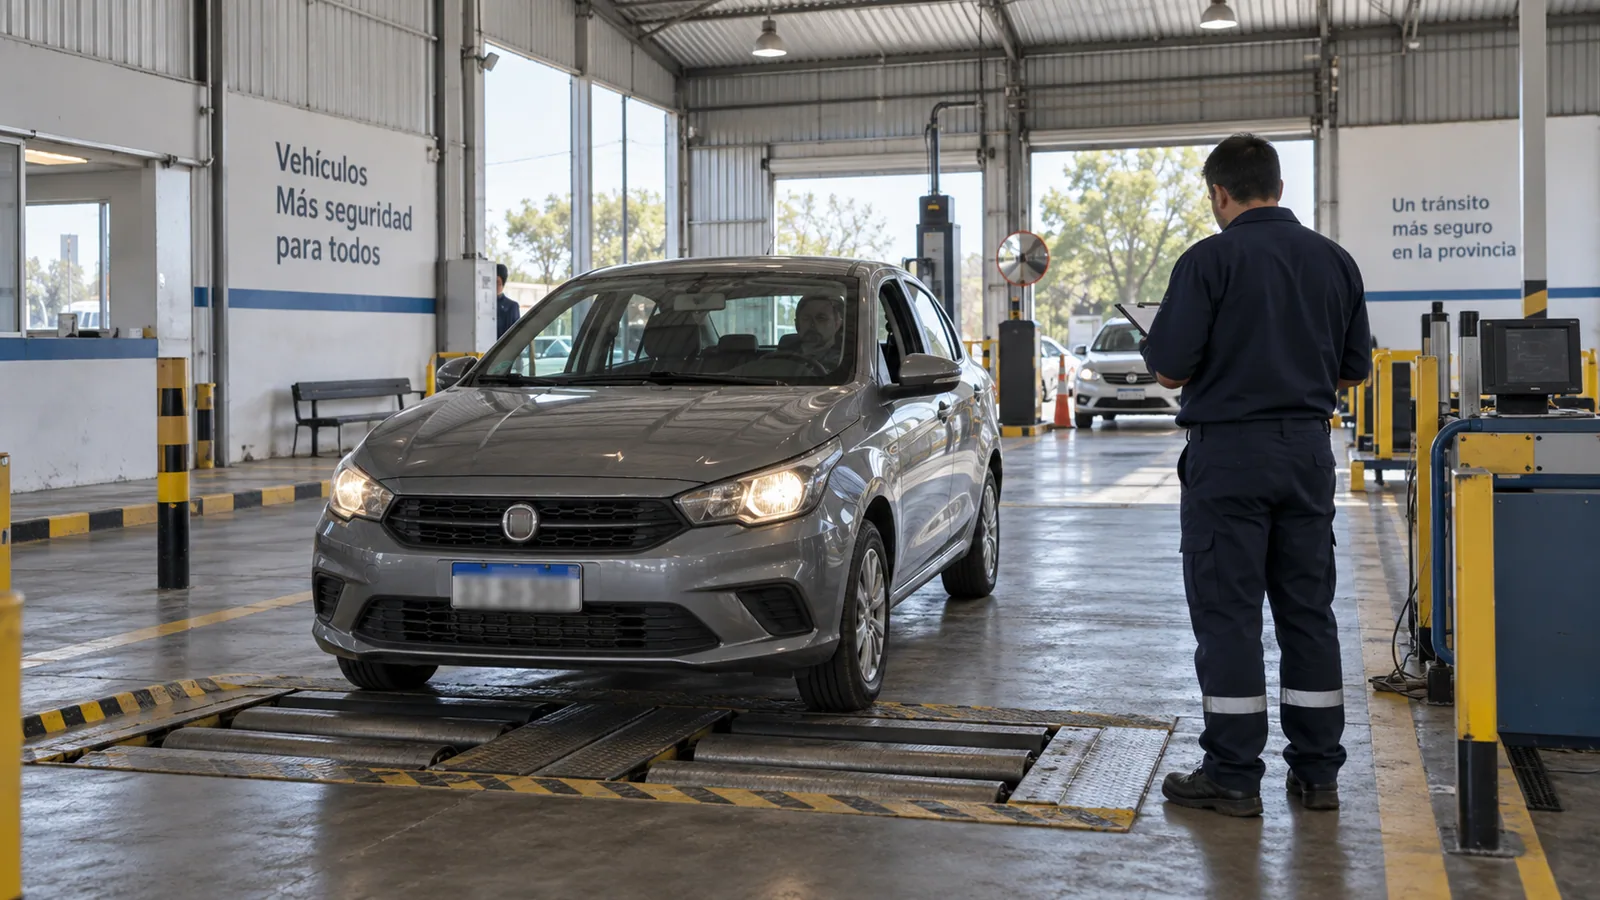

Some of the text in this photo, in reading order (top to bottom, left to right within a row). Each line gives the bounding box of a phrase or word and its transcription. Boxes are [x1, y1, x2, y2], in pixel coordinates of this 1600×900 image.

[275, 141, 368, 186] Vehículos
[276, 185, 412, 231] Más seguridad
[1392, 195, 1490, 213] Un tránsito
[1392, 220, 1493, 239] más seguro
[276, 235, 381, 266] para todos
[1392, 241, 1516, 262] en la provincia
